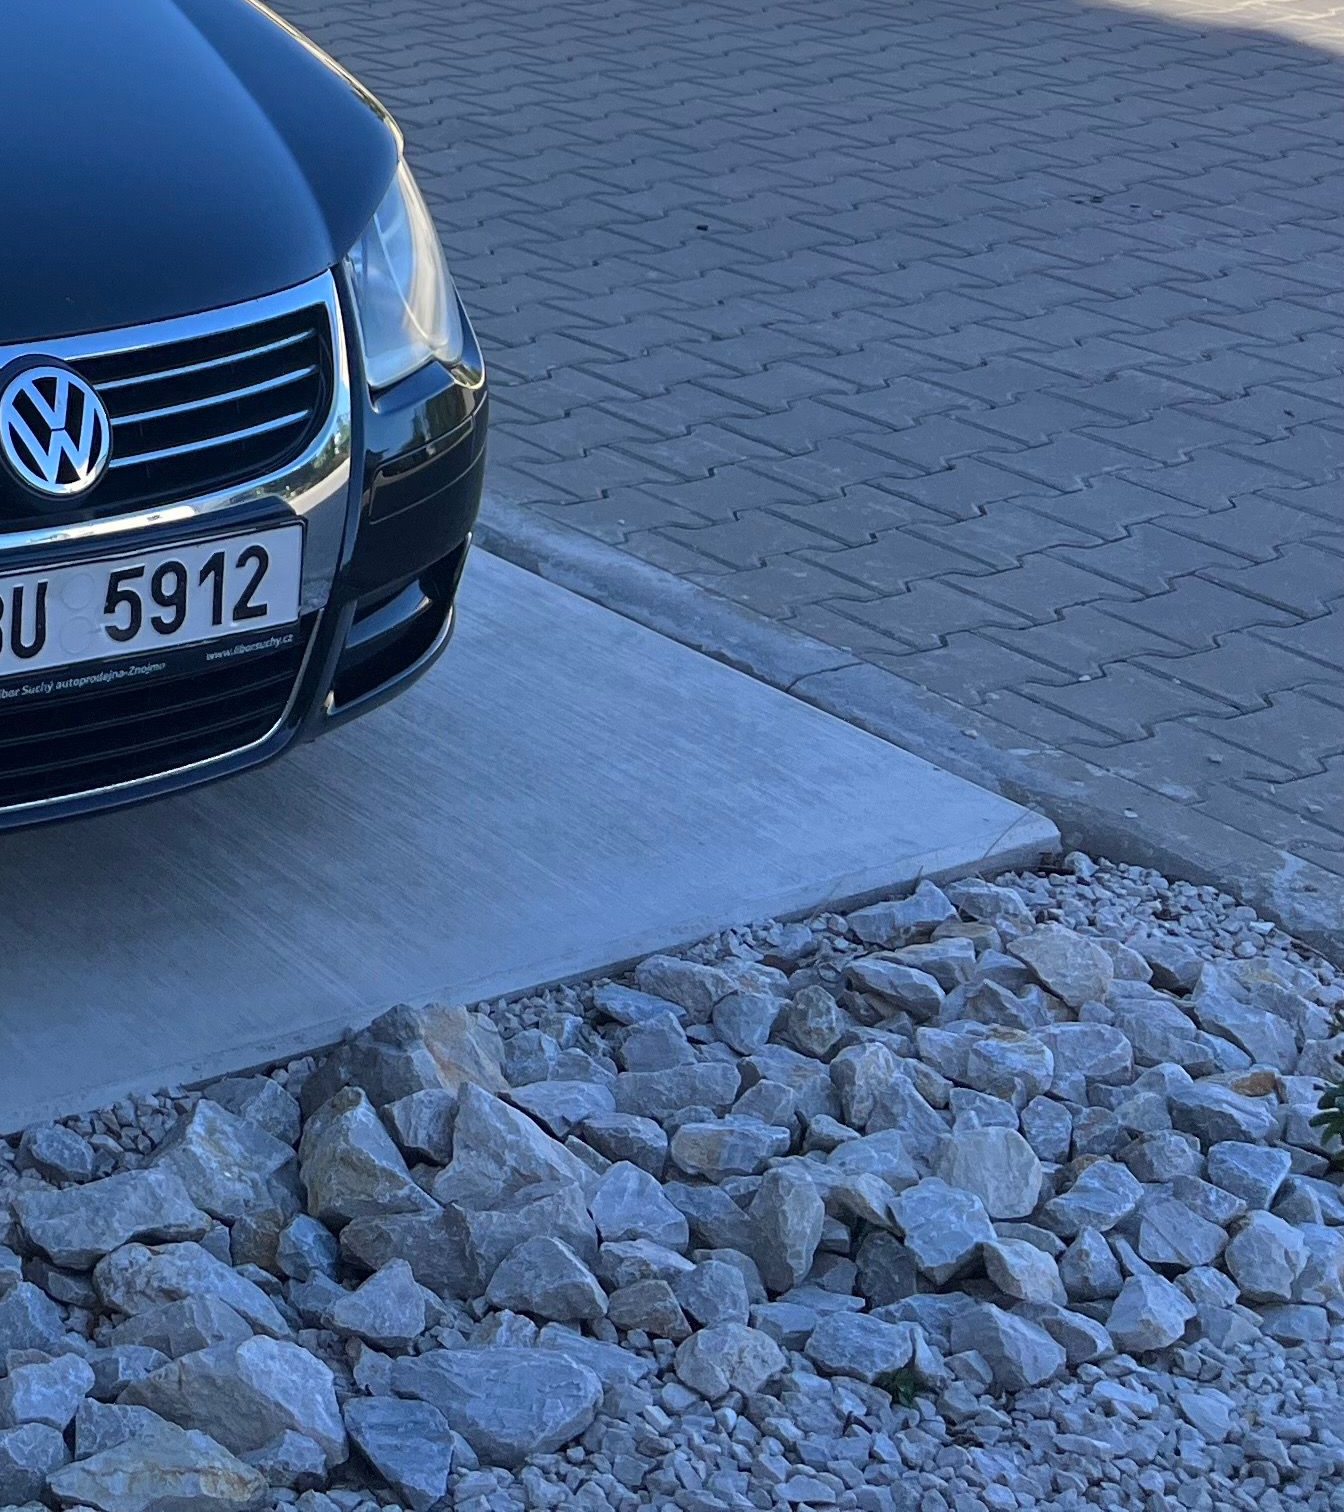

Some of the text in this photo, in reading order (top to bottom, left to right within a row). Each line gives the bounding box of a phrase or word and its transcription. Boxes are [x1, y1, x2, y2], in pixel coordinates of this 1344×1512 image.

[0, 366, 110, 494] VW
[104, 545, 269, 642] 5912
[21, 680, 54, 696] Suchý
